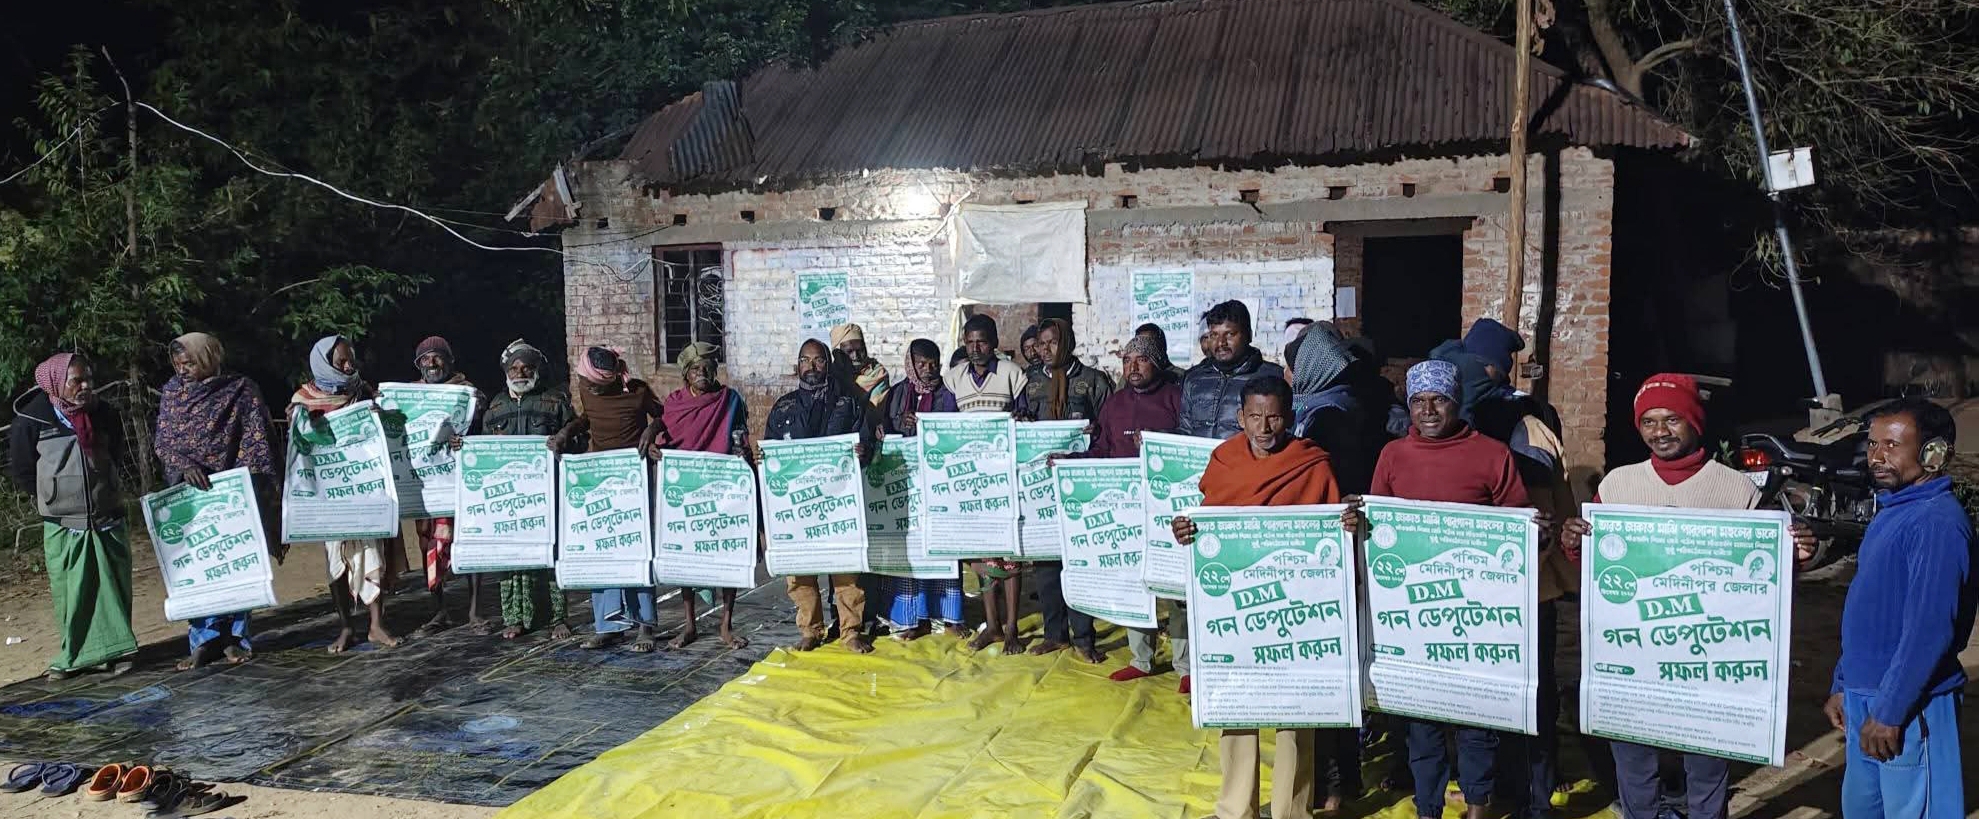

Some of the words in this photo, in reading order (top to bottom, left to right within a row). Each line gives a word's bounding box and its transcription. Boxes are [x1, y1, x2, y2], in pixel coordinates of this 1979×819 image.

[316, 453, 341, 465] D.M
[320, 456, 384, 483] ডেপুটেশন
[949, 462, 973, 477] D.M
[1024, 470, 1050, 485] D.M
[325, 485, 355, 499] সফল
[356, 478, 386, 494] করুন
[487, 484, 511, 497] D.M
[954, 472, 1010, 497] ডেপুটেশন
[490, 492, 547, 517] ডেপুটেশন
[793, 487, 818, 503] D.M
[959, 499, 983, 514] সফল
[984, 496, 1010, 511] করুন
[1175, 497, 1200, 510] D.M
[588, 500, 609, 515] D.M
[688, 502, 712, 516] D.M
[775, 509, 795, 523] গন
[798, 494, 857, 521] ডেপুটেশন
[493, 520, 518, 534] সফল
[519, 515, 546, 530] করুন
[591, 507, 643, 534] ডেপুটেশন
[667, 521, 687, 533] গন
[691, 513, 750, 537] ডেপুটেশন
[804, 524, 830, 539] সফল
[831, 518, 858, 535] করুন
[1087, 512, 1111, 527] D.M
[189, 528, 213, 546] D.M
[196, 528, 255, 561] ডেপুটেশন
[594, 536, 618, 551] সফল
[618, 531, 643, 547] করুন
[694, 540, 719, 553] সফল
[720, 537, 748, 552] করুন
[1070, 534, 1089, 547] গন
[204, 562, 231, 581] সফল
[232, 552, 260, 572] করুন
[1098, 553, 1122, 567] সফল
[1272, 552, 1308, 565] পশ্চিম
[1452, 550, 1488, 566] পশ্চিম
[1243, 566, 1295, 582] মেদিনীপুর
[1300, 568, 1336, 580] জেলার
[1419, 561, 1474, 581] মেদিনীপুর
[1480, 569, 1518, 583] জেলার
[1690, 561, 1733, 577] পশ্চিম
[1238, 584, 1279, 607] D.M
[1412, 581, 1456, 601] D.M
[1652, 577, 1716, 595] মেদিনীপুর
[1723, 581, 1768, 595] জেলার
[1643, 596, 1695, 618] D.M
[1206, 615, 1239, 638] গন
[1244, 599, 1343, 639] ডেপুটেশন
[1377, 609, 1412, 630] গন
[1418, 599, 1522, 639] ডেপুটেশন
[1602, 627, 1643, 649] গন
[1650, 614, 1772, 659] ডেপুটেশন
[1252, 642, 1294, 664] সফল
[1297, 637, 1342, 661] করুন
[1424, 642, 1469, 662] সফল
[1472, 643, 1521, 665] করুন
[1657, 661, 1709, 682] সফল
[1711, 660, 1768, 684] করুন
